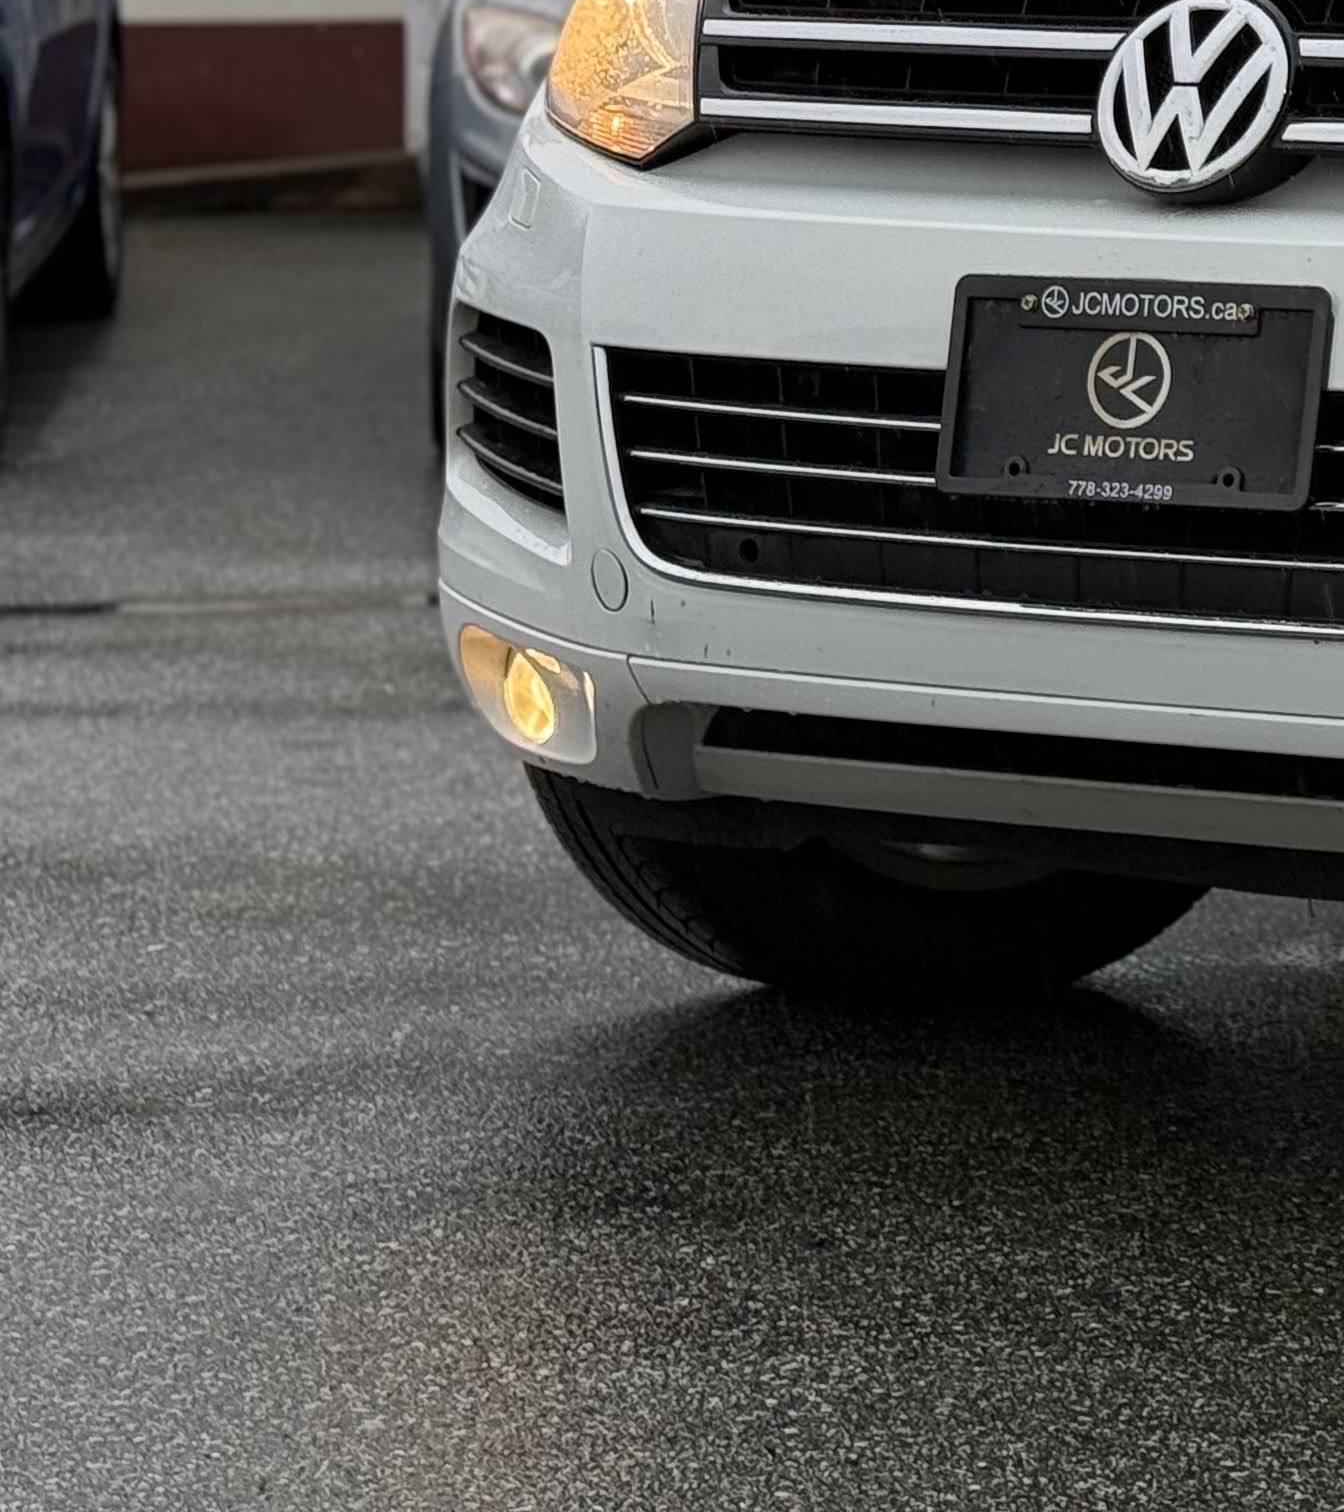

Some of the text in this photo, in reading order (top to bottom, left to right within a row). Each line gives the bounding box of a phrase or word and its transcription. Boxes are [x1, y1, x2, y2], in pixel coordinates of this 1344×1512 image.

[1071, 291, 1239, 321] JCMOTORS.ca
[1046, 433, 1195, 462] JC MOTORS
[1067, 479, 1174, 501] 778-323-4299
